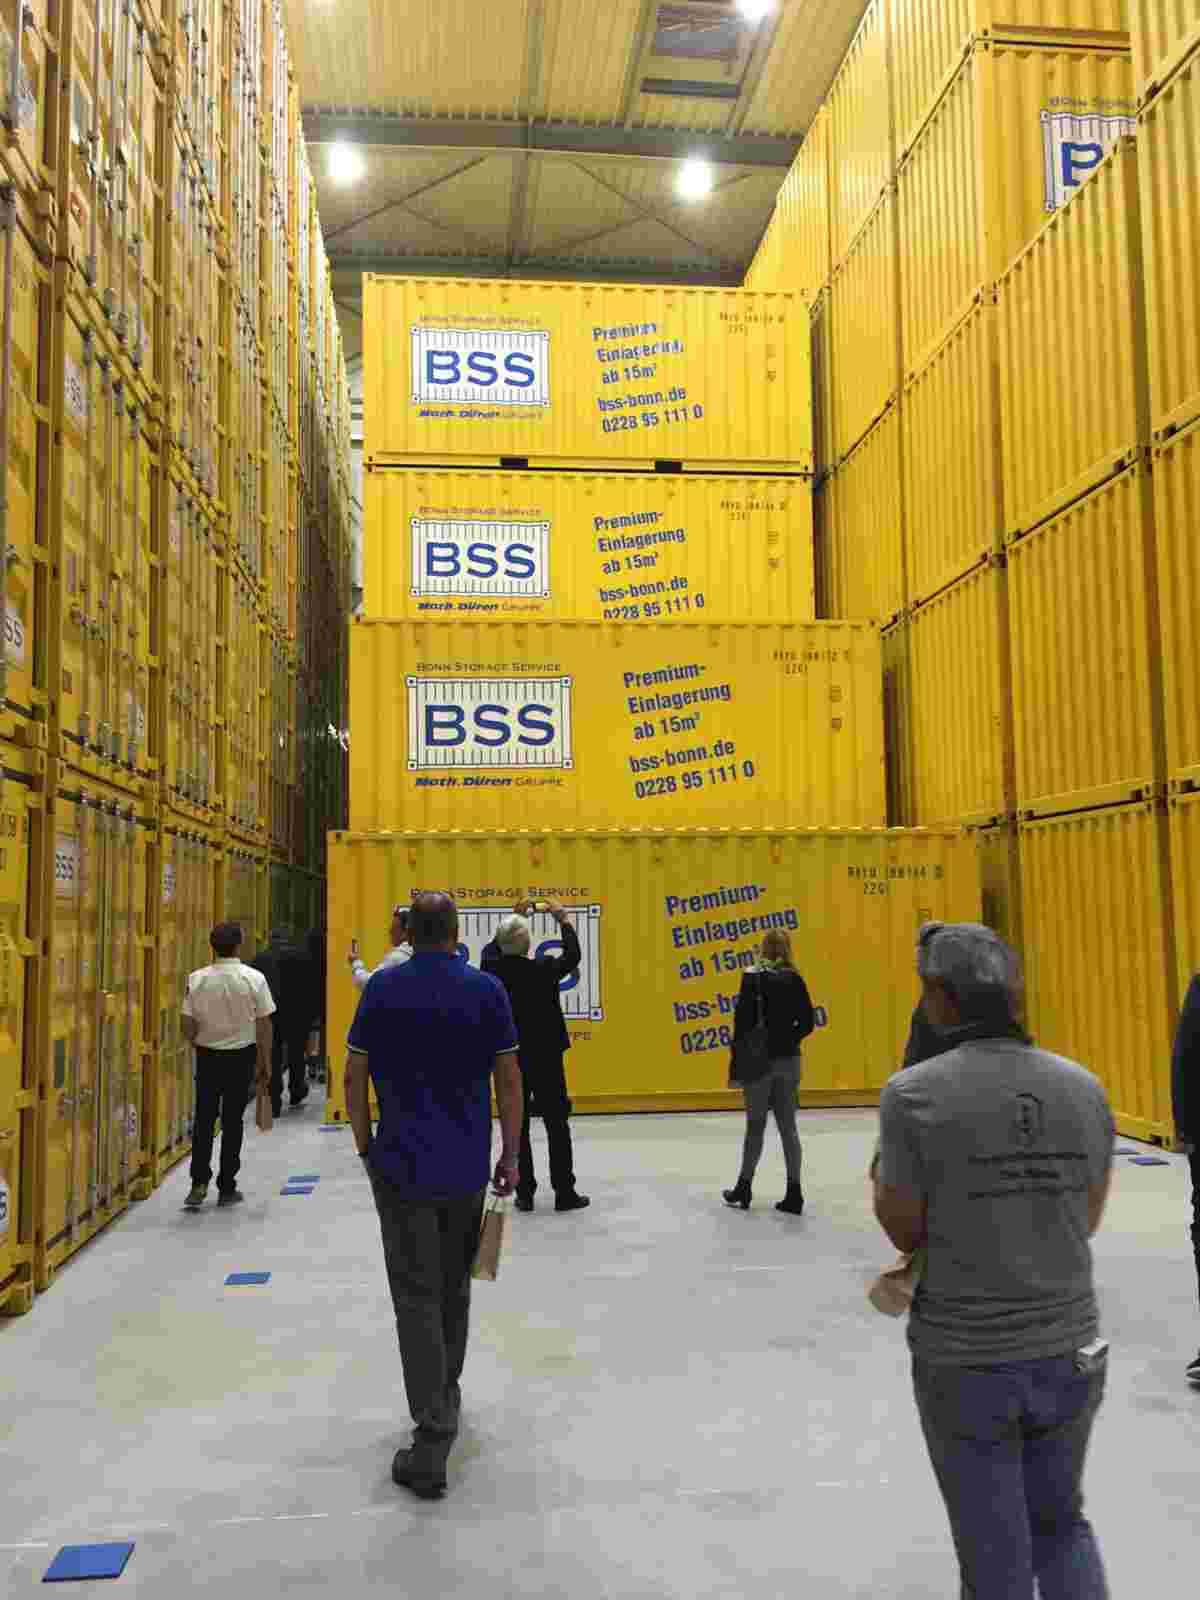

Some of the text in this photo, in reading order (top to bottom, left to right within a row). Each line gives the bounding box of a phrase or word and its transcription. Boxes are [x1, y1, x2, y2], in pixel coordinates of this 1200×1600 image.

[426, 350, 535, 388] BSS
[602, 414, 638, 433] 0228
[641, 411, 660, 427] 95
[664, 407, 688, 424] 111
[597, 528, 686, 553] Einlagerung
[426, 542, 536, 579] BSS
[602, 559, 621, 575] ab
[600, 576, 689, 602] bss-bonn.de
[643, 601, 661, 617] 95
[664, 595, 690, 614] 111
[624, 664, 707, 689] Premium-
[628, 683, 732, 714] Einlagerung
[425, 703, 555, 747] BSS
[633, 720, 655, 740] ab
[629, 739, 736, 773] bss-bonn.de
[634, 759, 755, 800] 0228 95 111 0
[527, 887, 591, 898] SERVICE
[664, 884, 768, 917] Premium-
[672, 908, 799, 948] Einlagerung
[679, 956, 705, 980] ab
[680, 1025, 732, 1055] 0228
